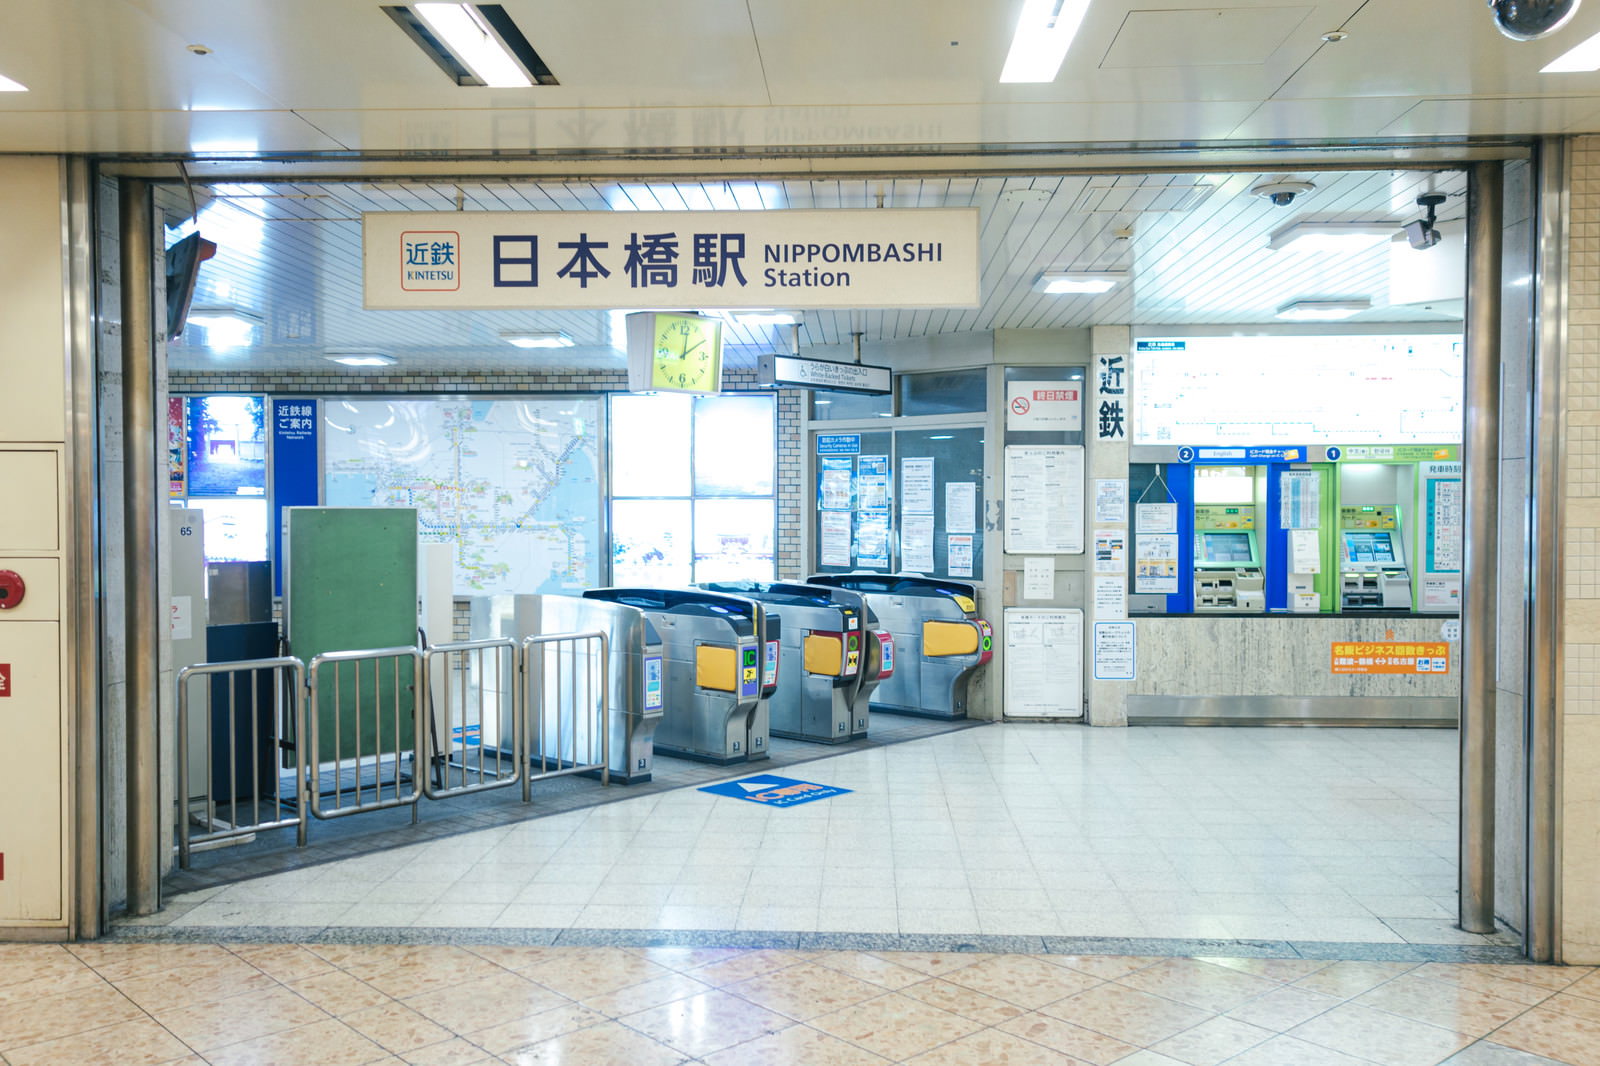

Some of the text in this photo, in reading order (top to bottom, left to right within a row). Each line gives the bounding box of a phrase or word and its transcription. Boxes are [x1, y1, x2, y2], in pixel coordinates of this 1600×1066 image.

[405, 241, 455, 266] 近鉄
[764, 242, 942, 263] NIPPOMBASHI
[492, 231, 748, 289] 日本橋駅
[407, 270, 454, 281] KINTETSU
[764, 266, 850, 288] Station
[680, 325, 690, 336] 12
[679, 374, 686, 384] 6
[1099, 355, 1125, 438] 近鉄
[278, 405, 312, 417] 近鉄線
[279, 418, 312, 430] ご案内
[1331, 450, 1336, 458] 1
[180, 526, 192, 536] 65
[743, 649, 756, 666] IC
